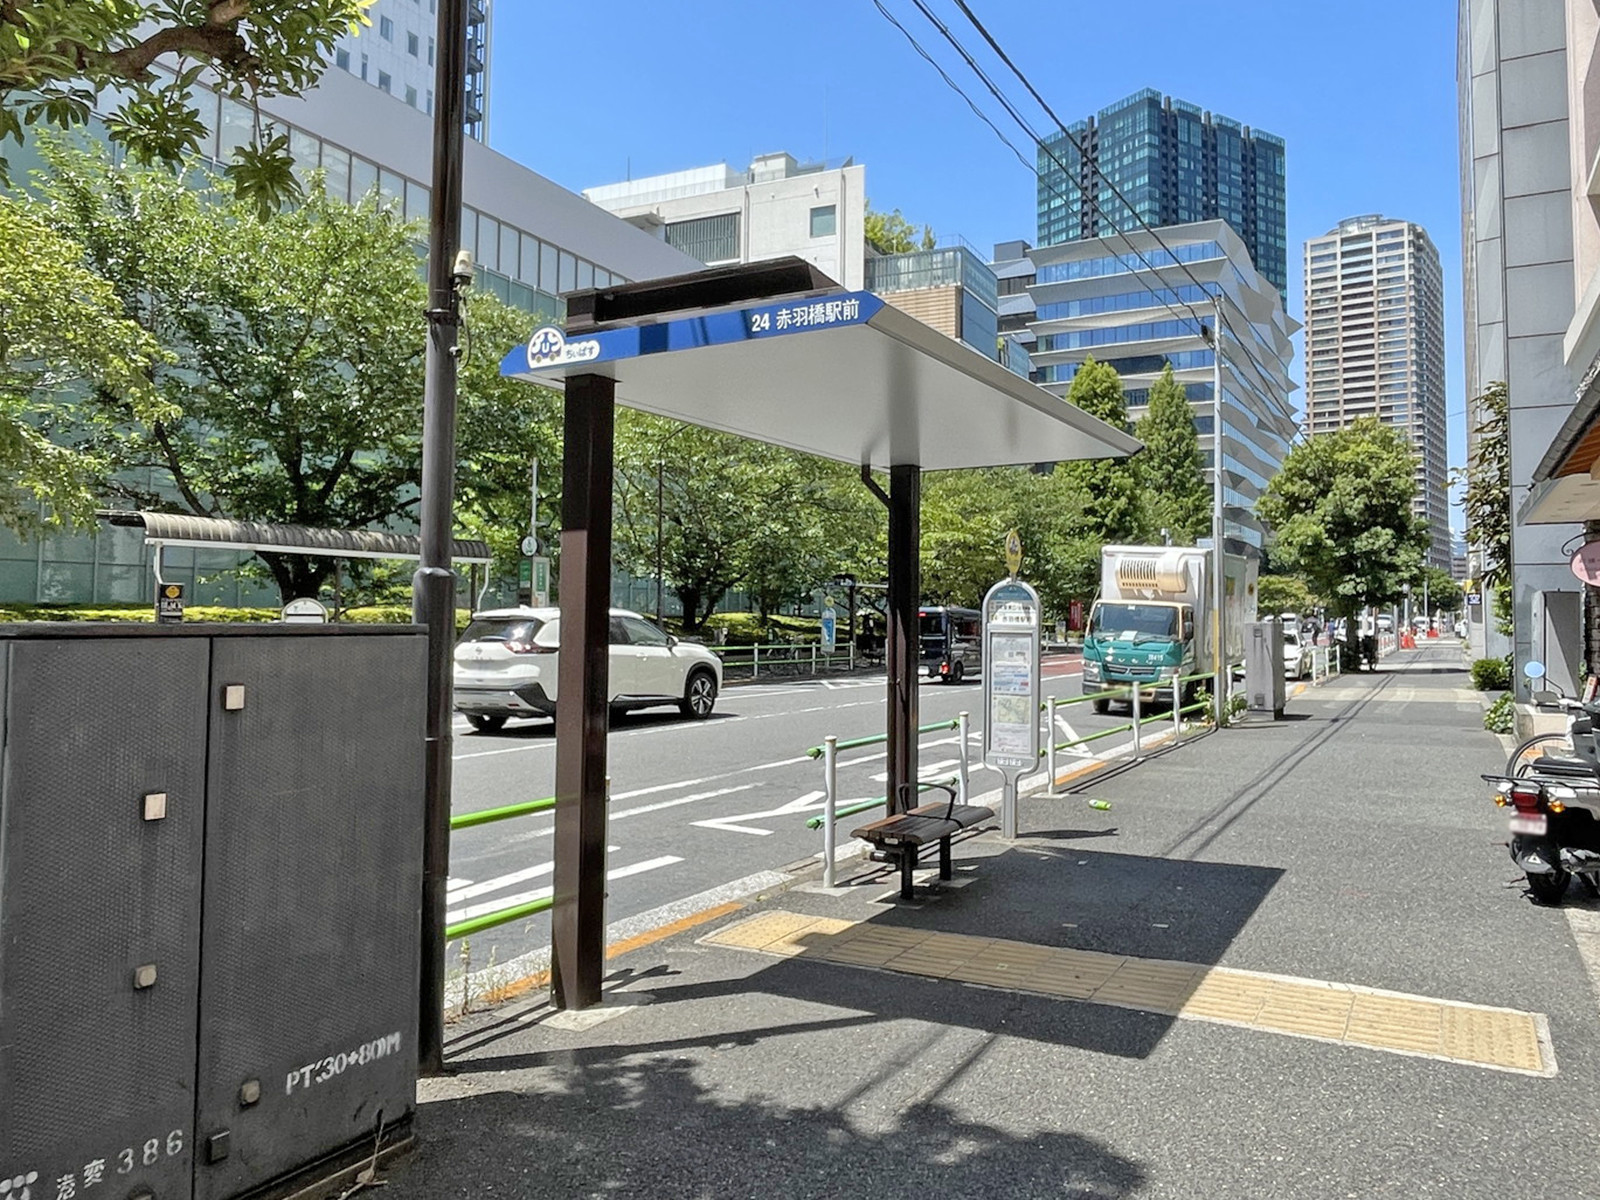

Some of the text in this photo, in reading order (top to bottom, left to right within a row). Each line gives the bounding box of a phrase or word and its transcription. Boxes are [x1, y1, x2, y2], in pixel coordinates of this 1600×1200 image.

[751, 298, 860, 332] 24 赤羽橋駅前
